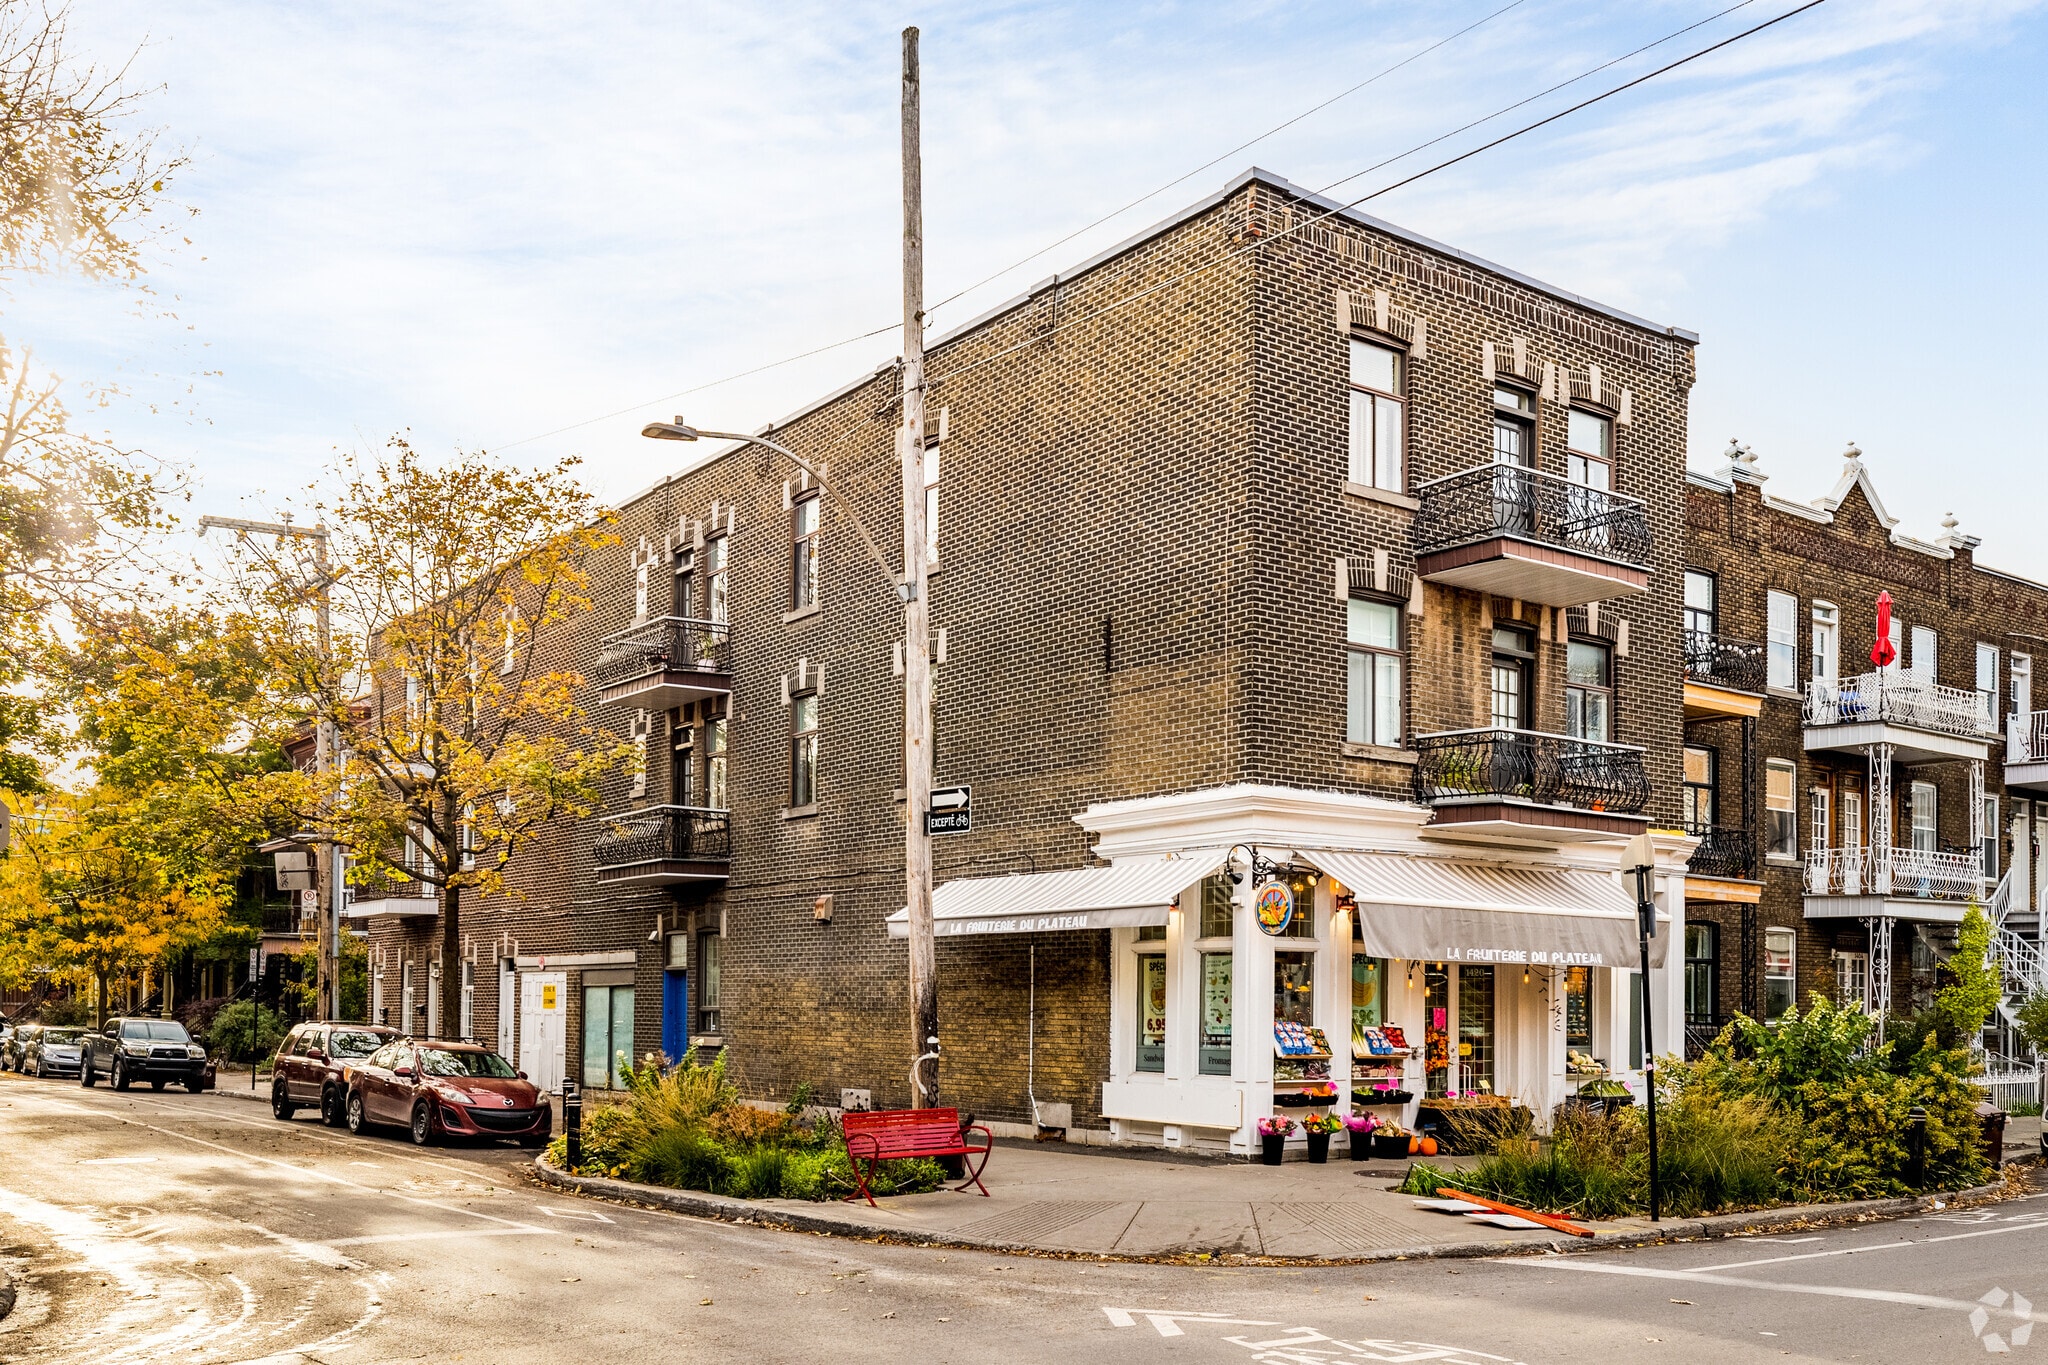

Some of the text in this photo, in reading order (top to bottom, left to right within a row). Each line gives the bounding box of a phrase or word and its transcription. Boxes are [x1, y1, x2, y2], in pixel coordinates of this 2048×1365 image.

[931, 814, 955, 828] EXCEPTÉ
[950, 915, 1088, 934] LA FRUITERIE DU PLATEAU
[1446, 948, 1603, 964] LA FRUITERIE DU PLATEAU
[1466, 969, 1485, 977] 1420
